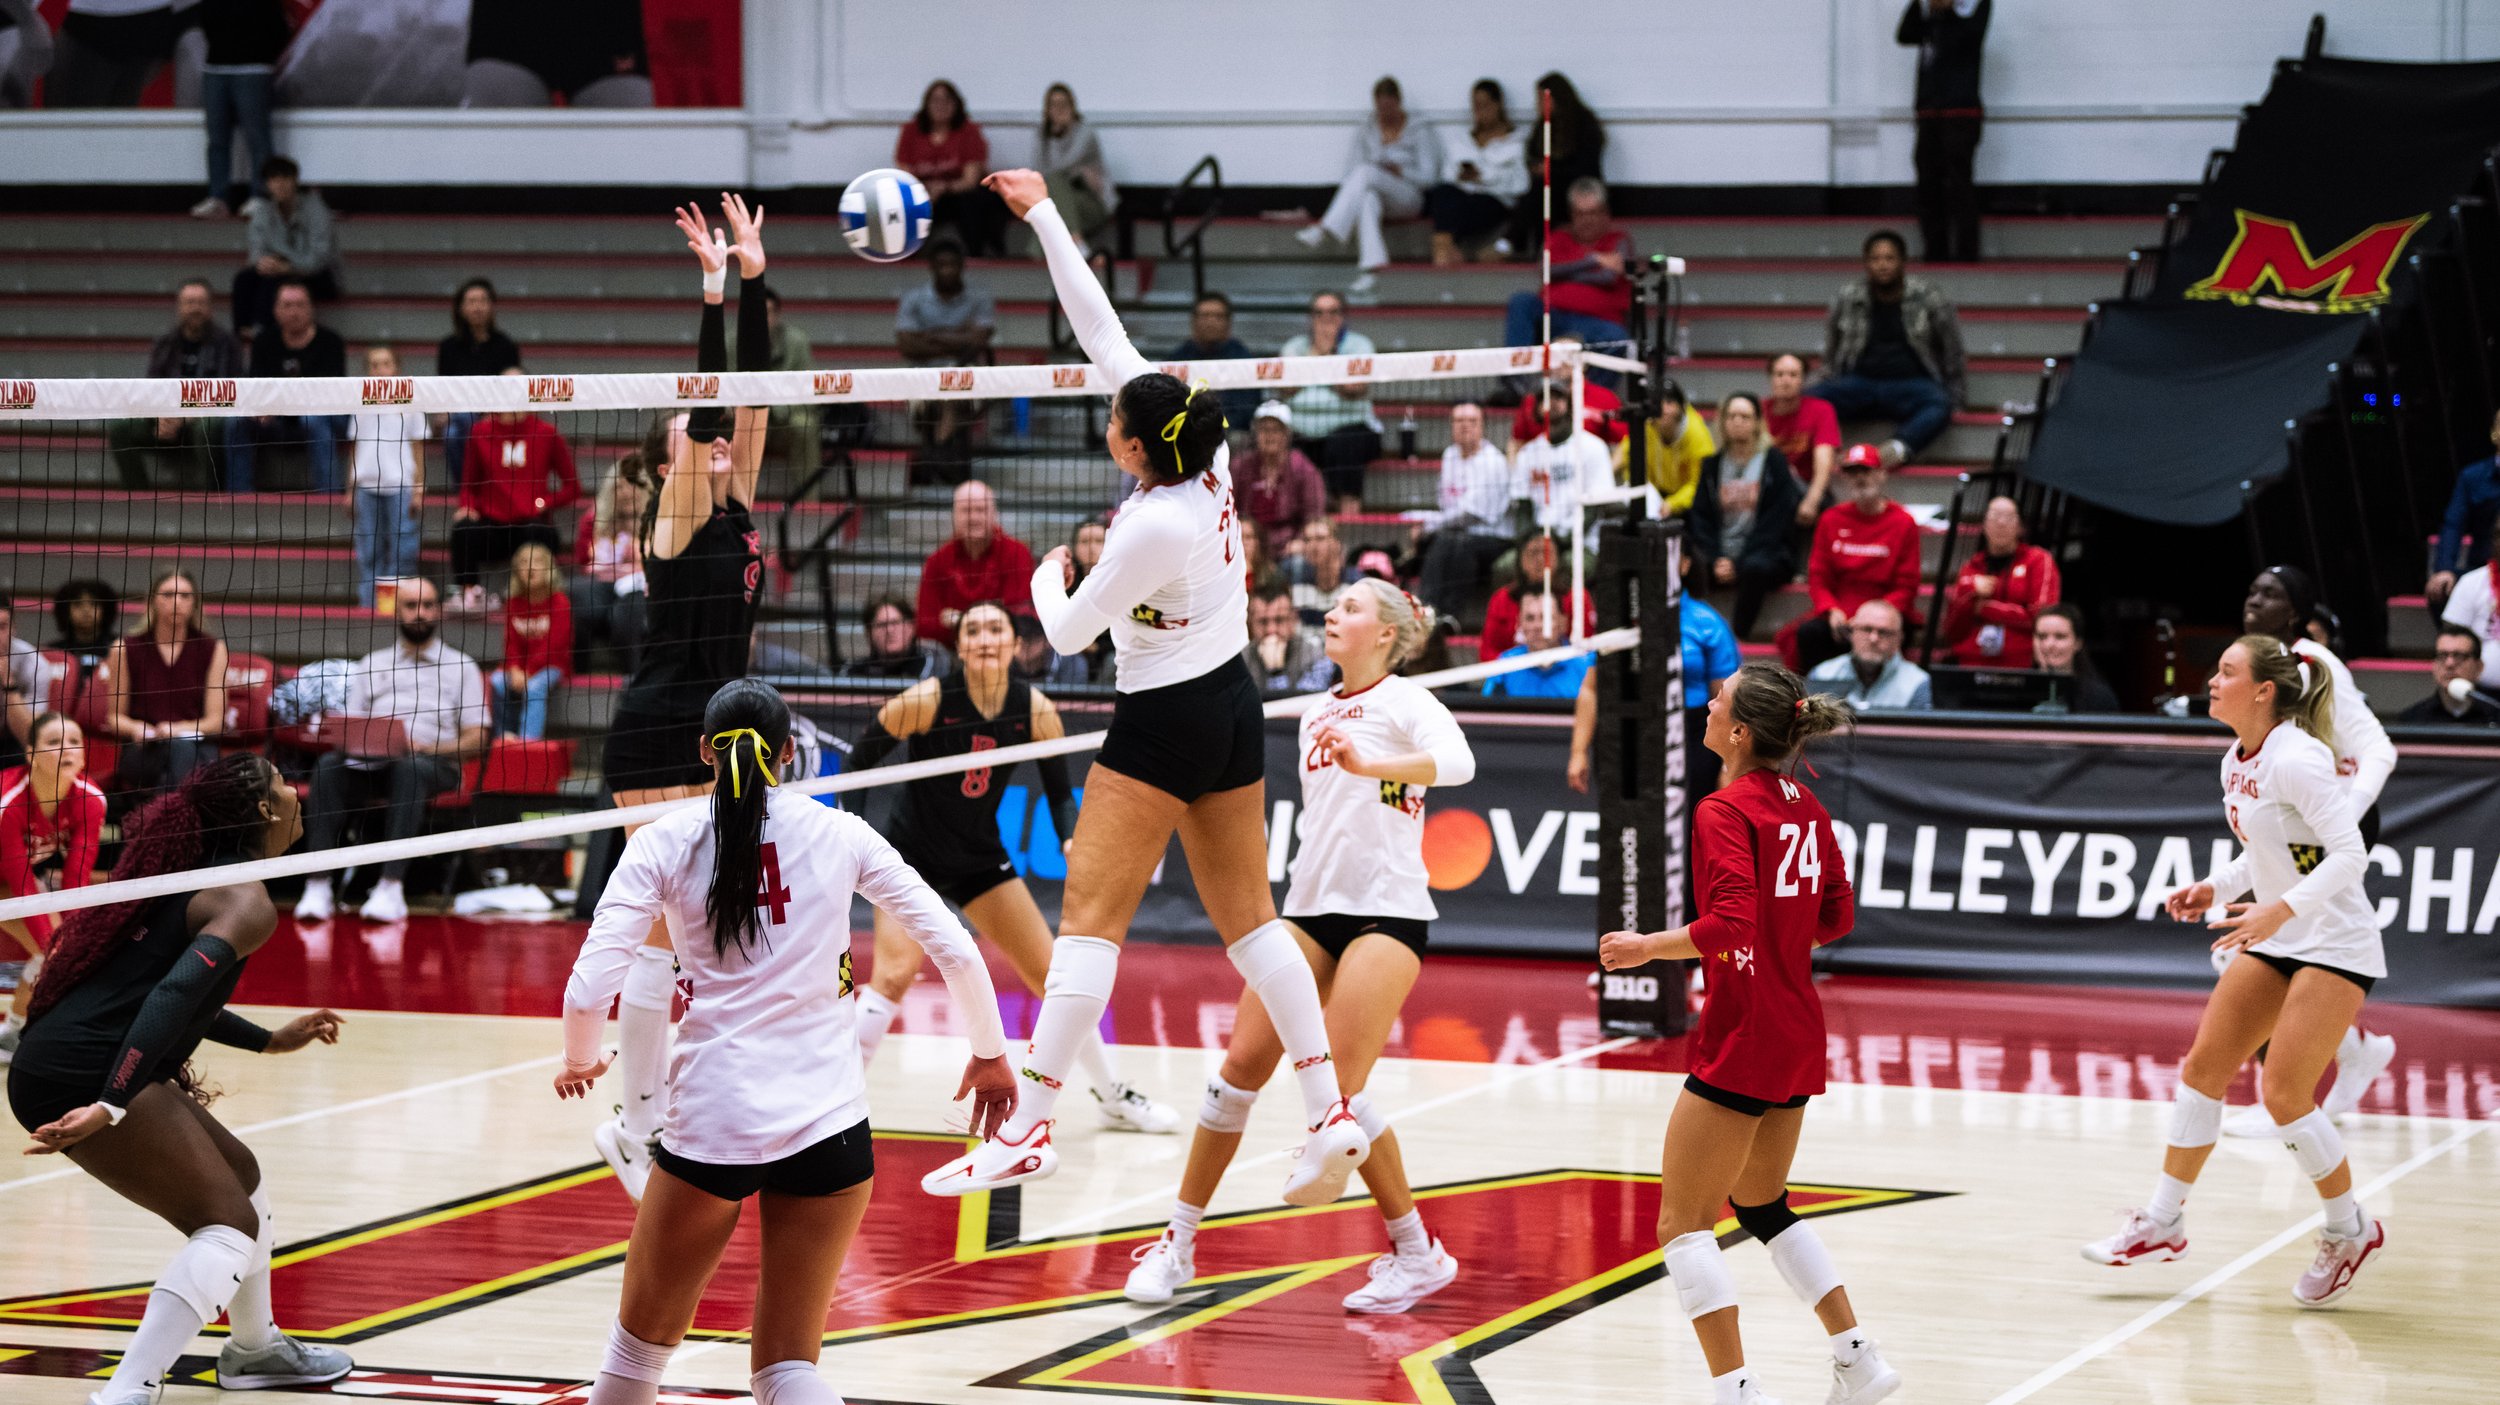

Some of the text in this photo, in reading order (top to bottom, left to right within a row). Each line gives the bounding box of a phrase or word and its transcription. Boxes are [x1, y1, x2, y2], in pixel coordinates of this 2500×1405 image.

[2186, 208, 2432, 301] M
[180, 380, 237, 402] MARYLAND
[362, 378, 414, 400] MARYLAND
[528, 377, 574, 398] MARYLAND
[1778, 778, 1801, 802] M
[1775, 820, 1821, 897] 24
[753, 842, 792, 926] 4
